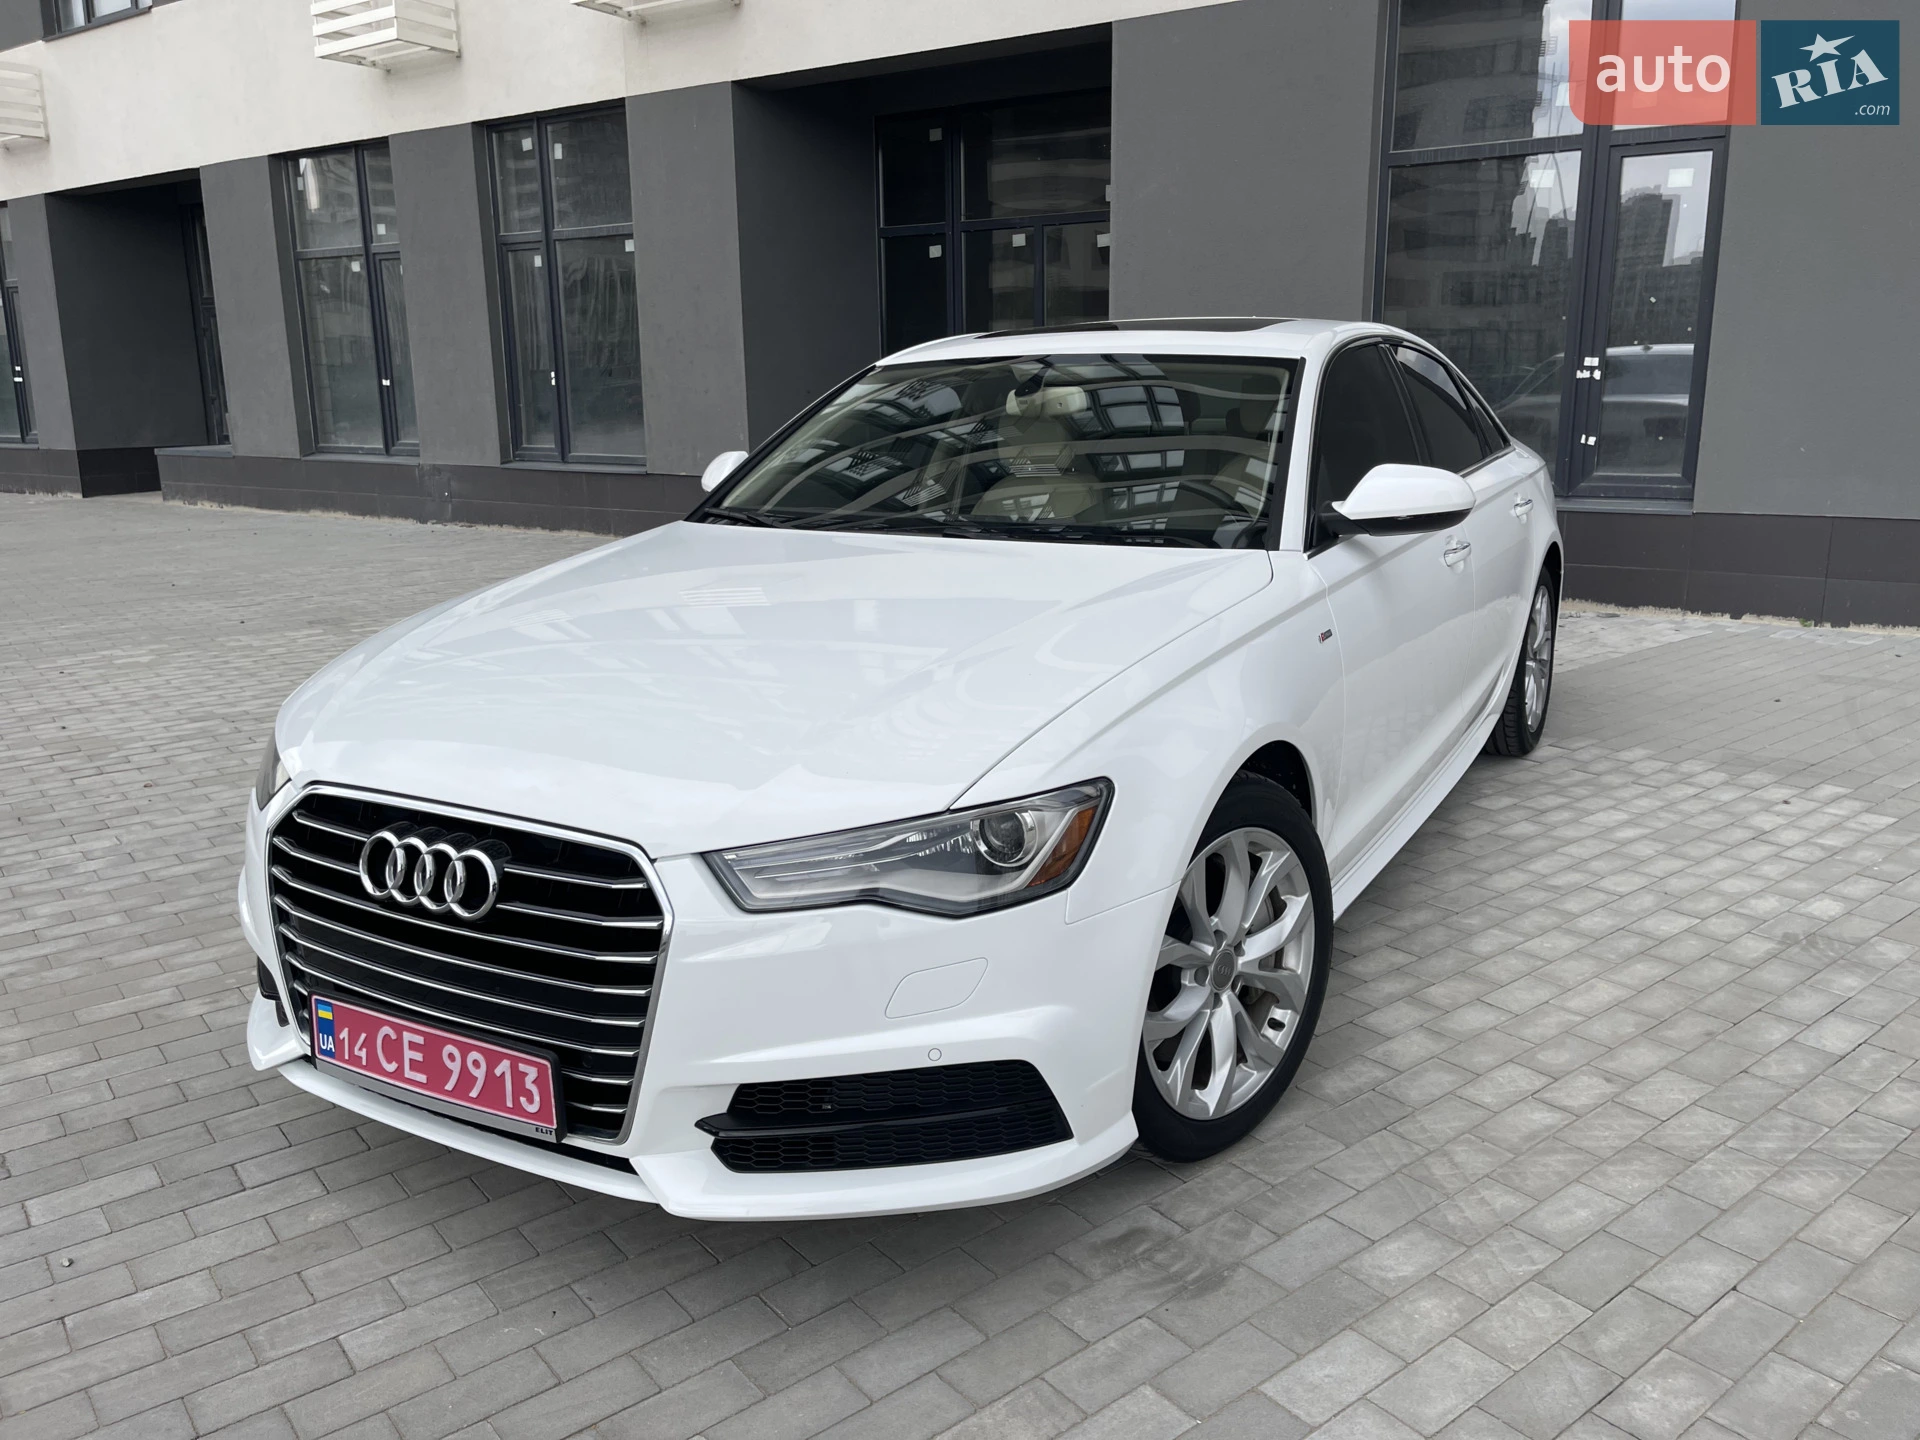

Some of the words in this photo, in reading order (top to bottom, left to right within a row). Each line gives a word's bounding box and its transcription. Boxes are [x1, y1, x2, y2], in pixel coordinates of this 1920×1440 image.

[319, 1033, 335, 1052] UA
[339, 1027, 367, 1066] 14
[376, 1026, 427, 1084] CE
[442, 1044, 540, 1114] 9913
